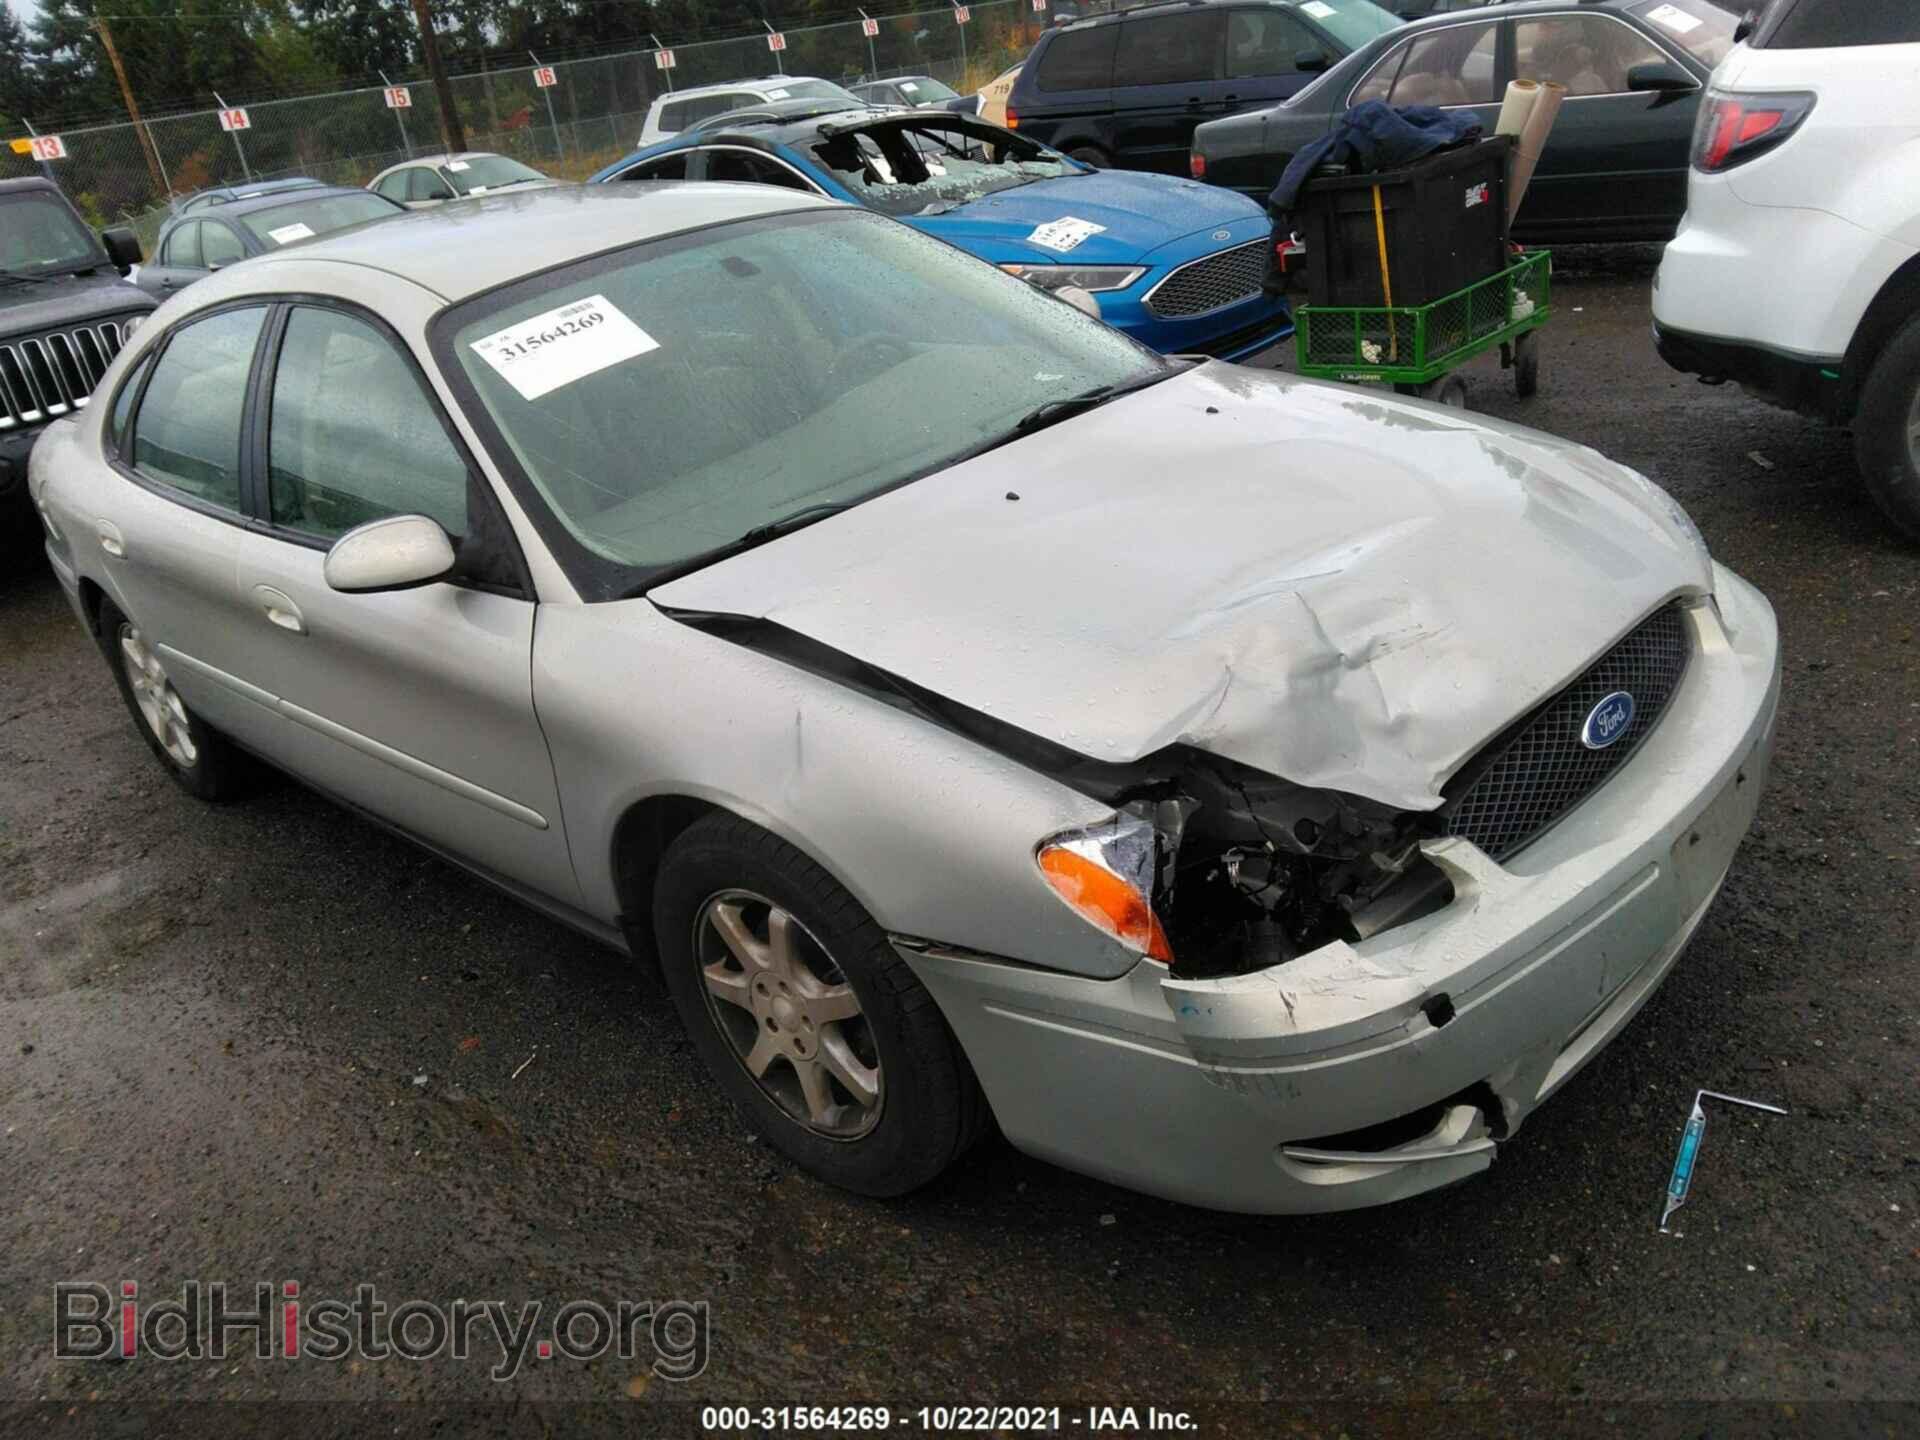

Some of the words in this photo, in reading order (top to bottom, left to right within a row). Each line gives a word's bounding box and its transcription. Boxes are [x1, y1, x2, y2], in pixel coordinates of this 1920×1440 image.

[957, 7, 968, 21] 20
[865, 19, 877, 33] 19
[771, 34, 784, 49] 18
[659, 51, 671, 66] 17
[537, 68, 555, 85] 16
[387, 88, 408, 106] 15
[223, 109, 246, 129] 14
[35, 137, 60, 159] 13
[499, 311, 605, 361] 31564269
[1596, 703, 1626, 737] Ford
